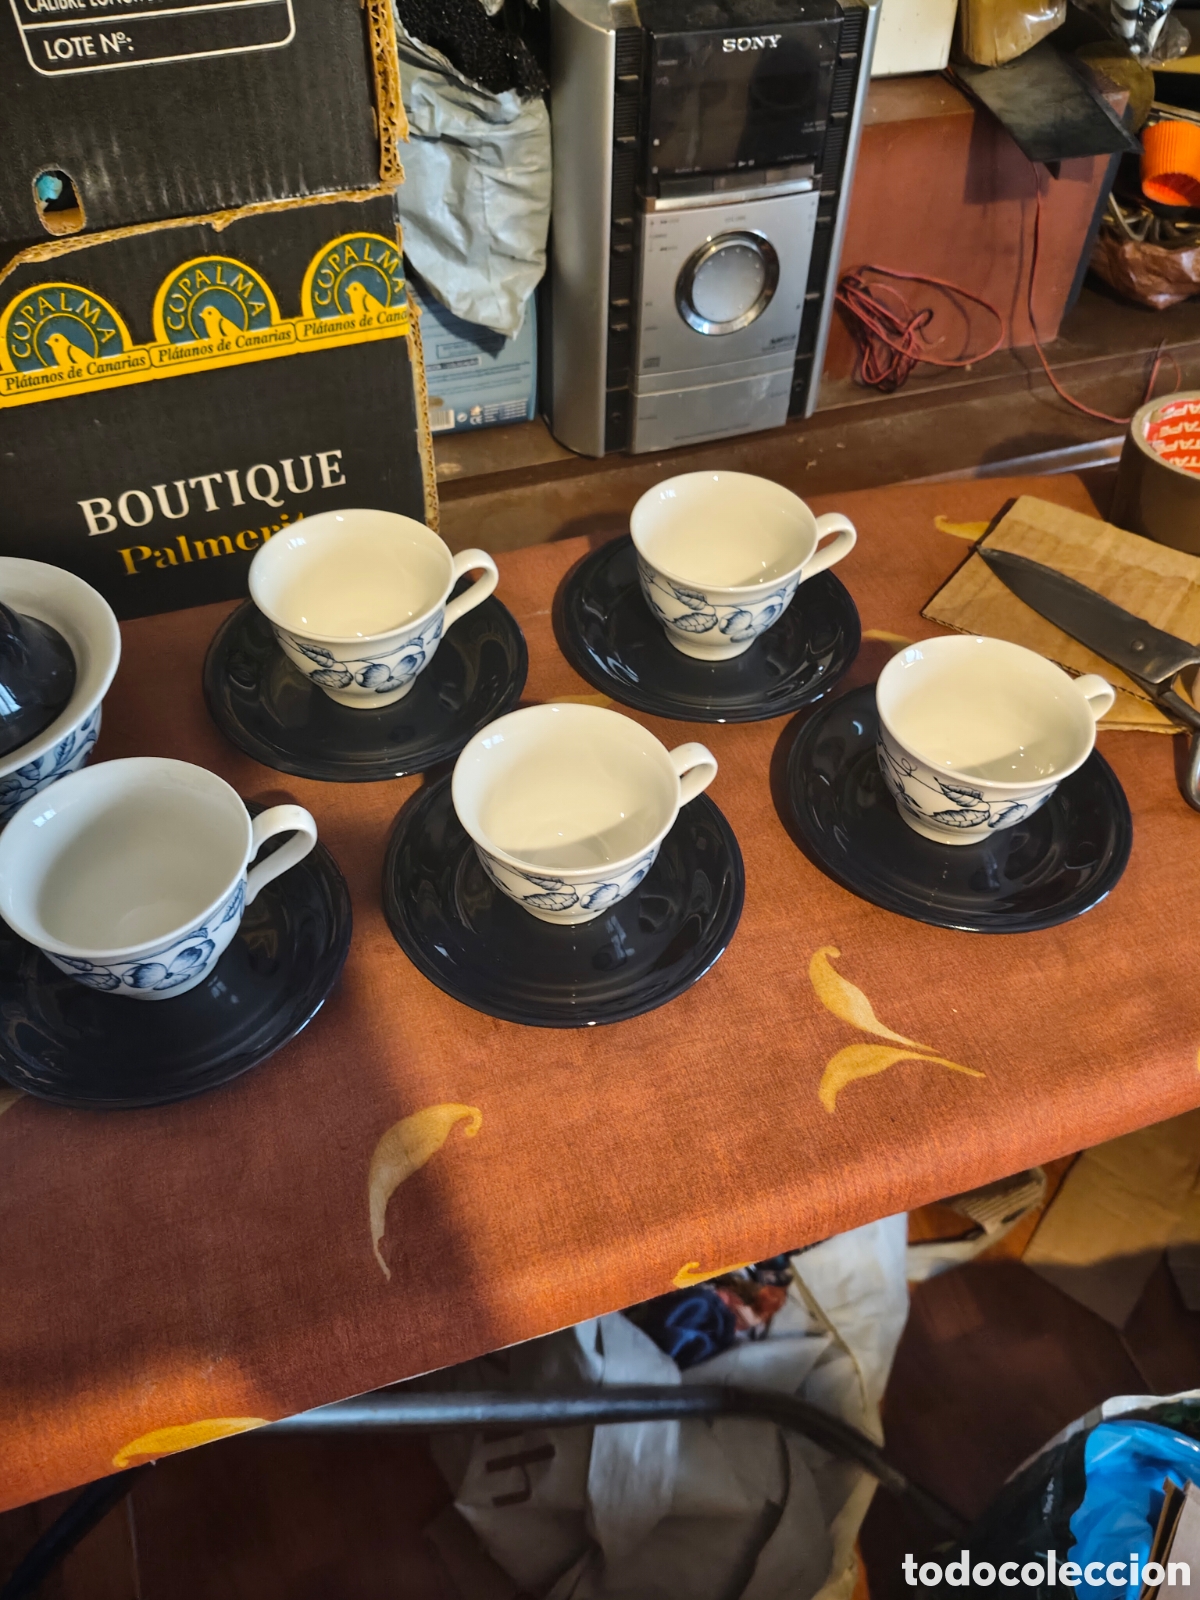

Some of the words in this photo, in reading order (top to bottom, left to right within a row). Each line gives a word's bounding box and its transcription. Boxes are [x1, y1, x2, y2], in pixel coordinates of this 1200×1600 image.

[43, 36, 96, 61] LOTE
[722, 34, 782, 53] SONY
[314, 242, 406, 306] COPALMA
[165, 265, 267, 331] COPALMA
[11, 292, 118, 359] COPALMA
[303, 319, 356, 337] Plátanos
[359, 314, 373, 327] de
[158, 344, 213, 362] Plátanos
[216, 339, 231, 352] de
[235, 329, 292, 348] Canarias
[5, 371, 63, 391] Plátanos
[67, 366, 83, 379] de
[86, 356, 146, 375] Canarias
[77, 450, 347, 537] BOUTIQUE
